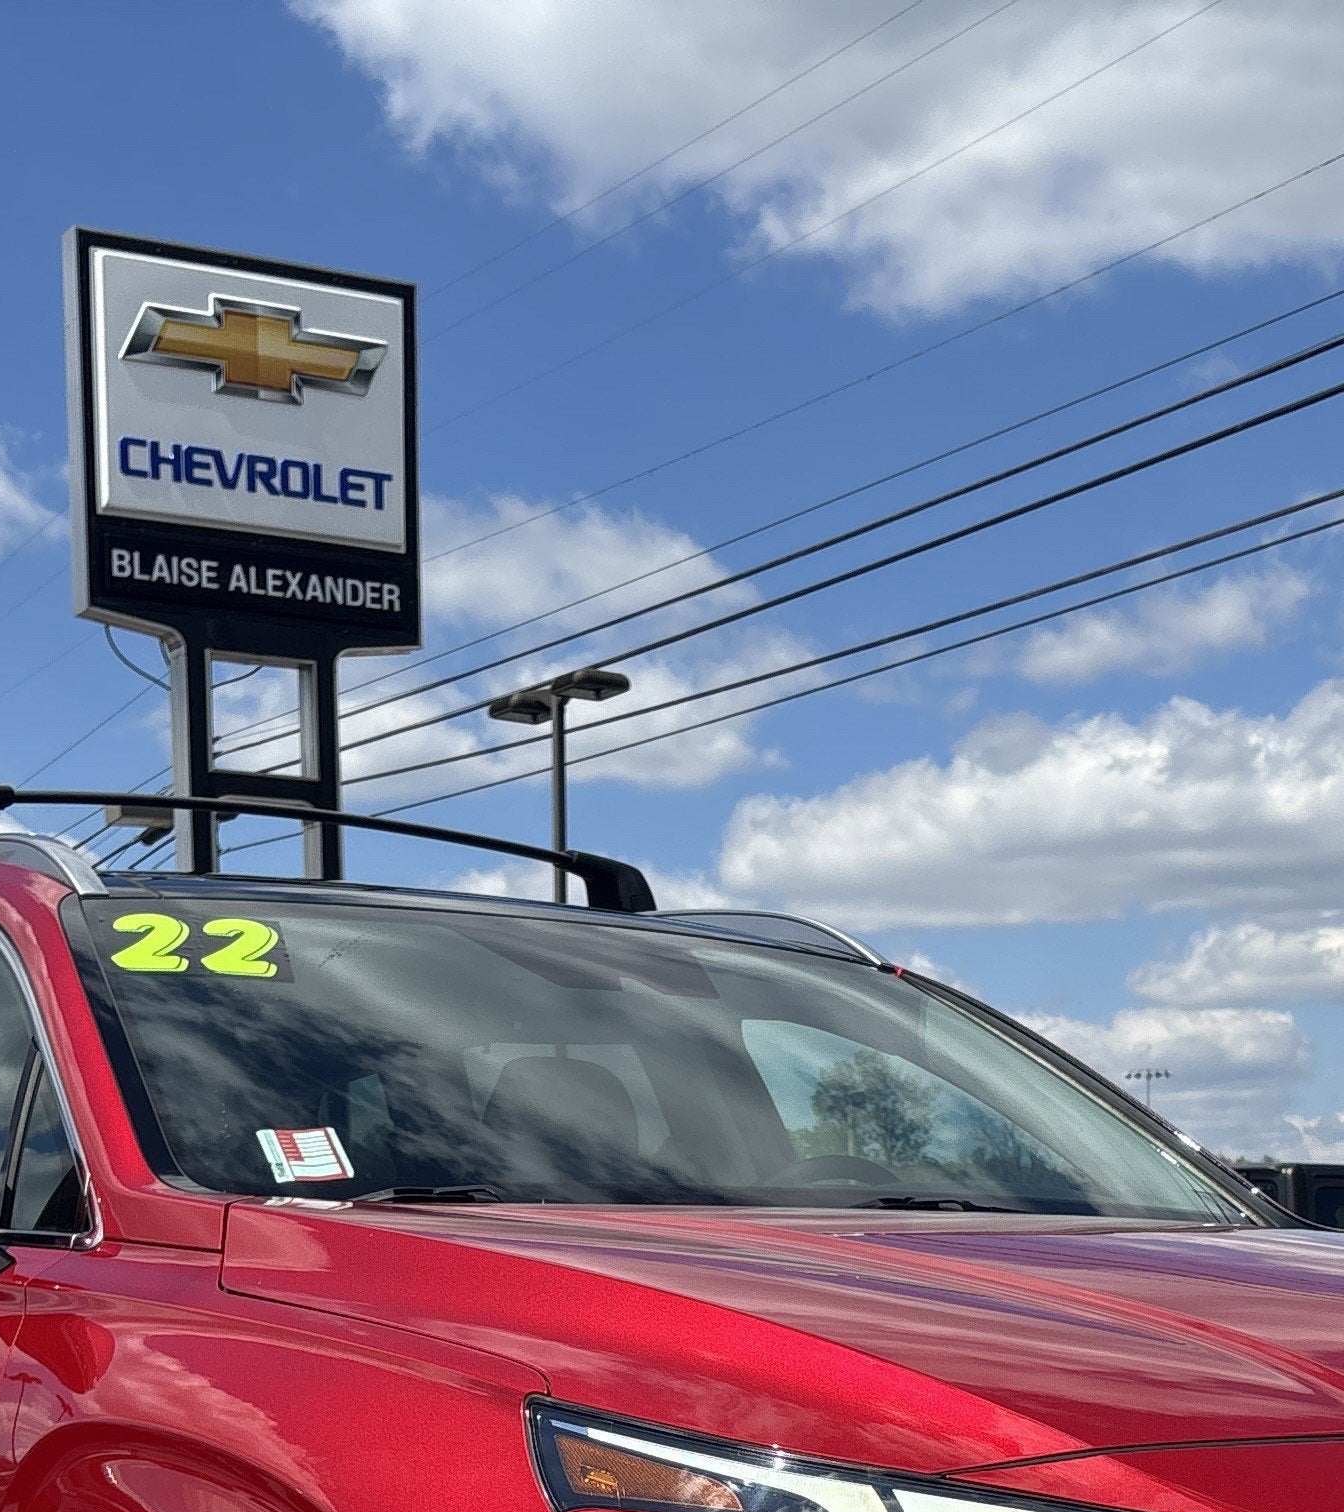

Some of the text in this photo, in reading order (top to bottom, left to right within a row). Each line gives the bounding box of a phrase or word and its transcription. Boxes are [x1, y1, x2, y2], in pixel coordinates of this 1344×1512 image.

[119, 437, 392, 510] CHEVROLET
[111, 548, 401, 612] BLAISE ALEXANDER
[111, 913, 279, 977] 22
